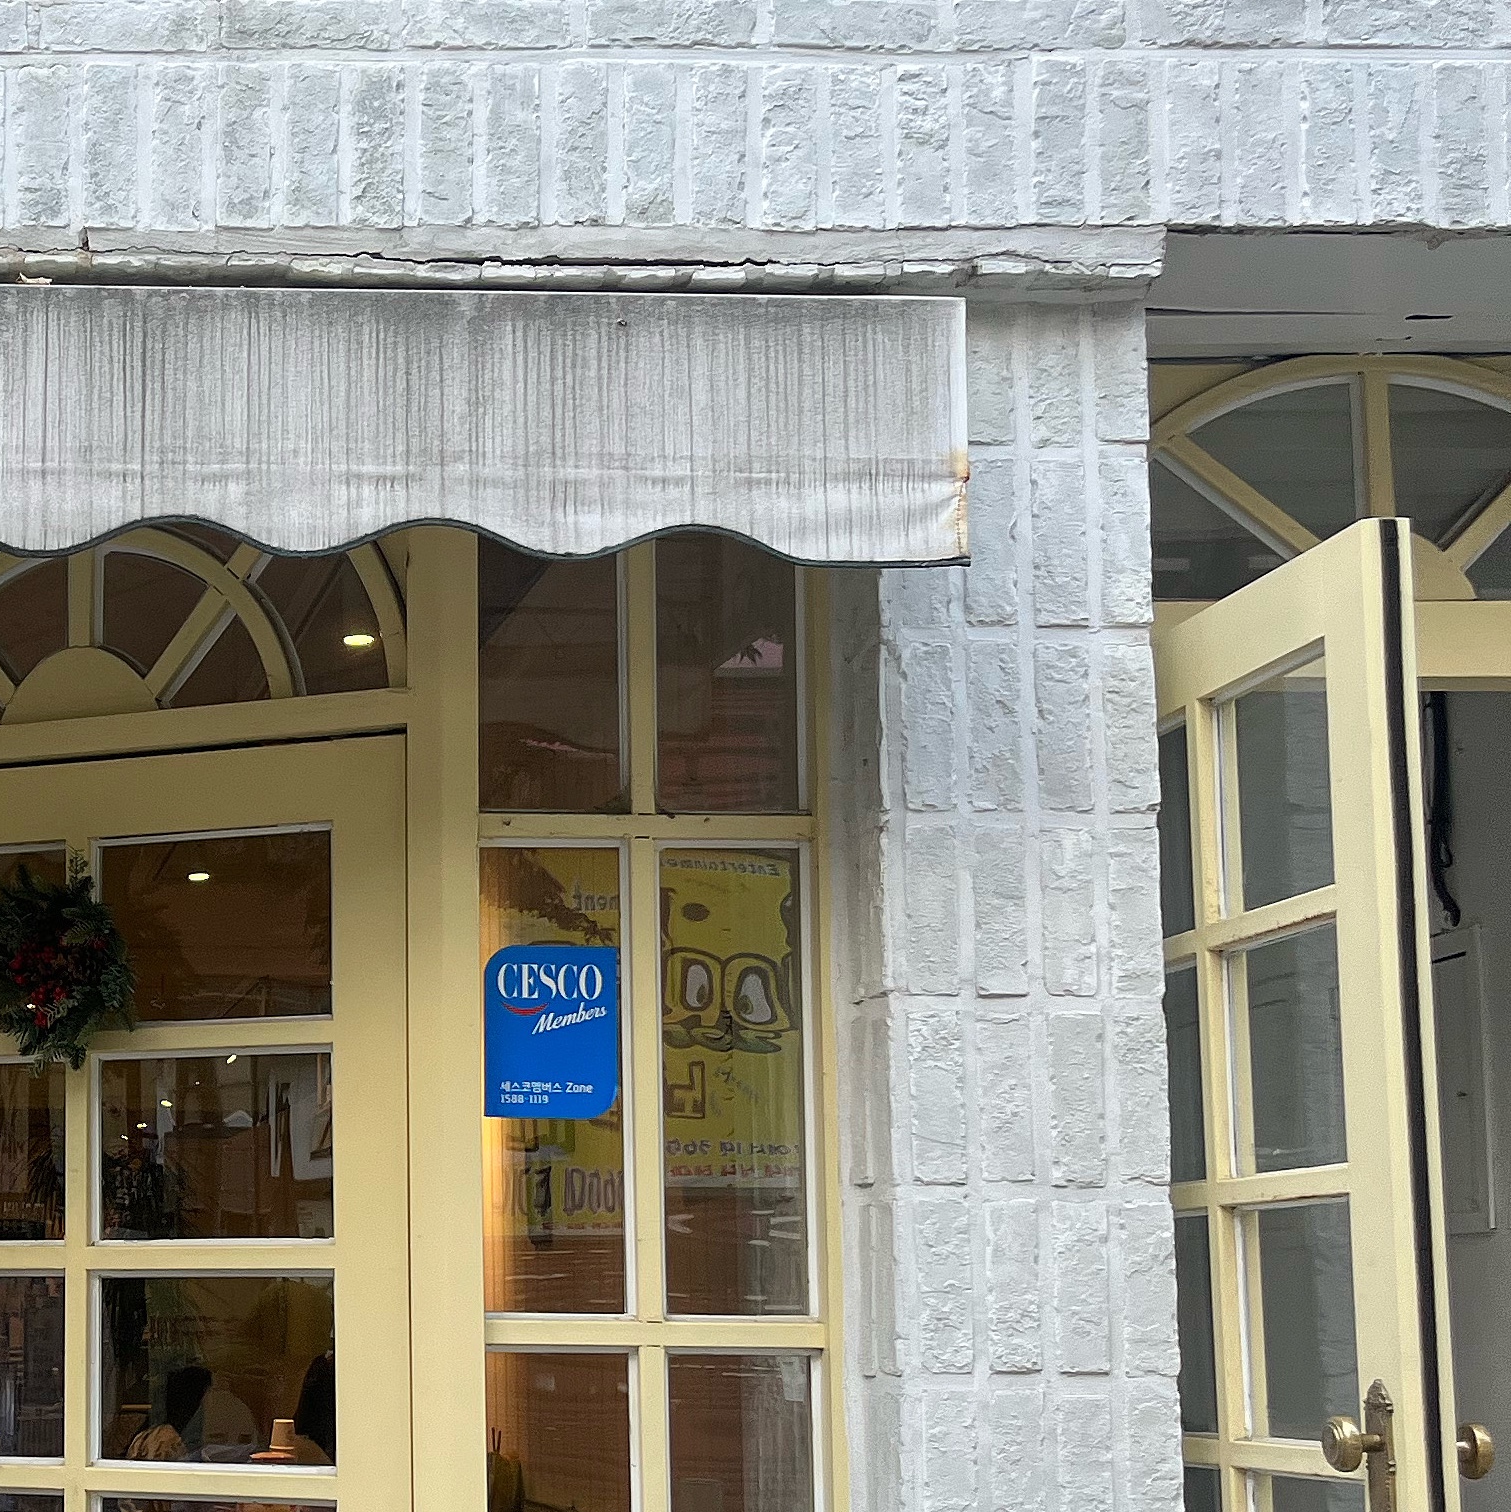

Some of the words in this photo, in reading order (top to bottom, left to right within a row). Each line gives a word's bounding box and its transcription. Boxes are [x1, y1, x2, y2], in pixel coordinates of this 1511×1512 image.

[497, 962, 603, 1000] CESCO
[531, 1001, 607, 1035] Members
[500, 1080, 563, 1093] 세스코멤버스
[565, 1081, 594, 1093] Zone
